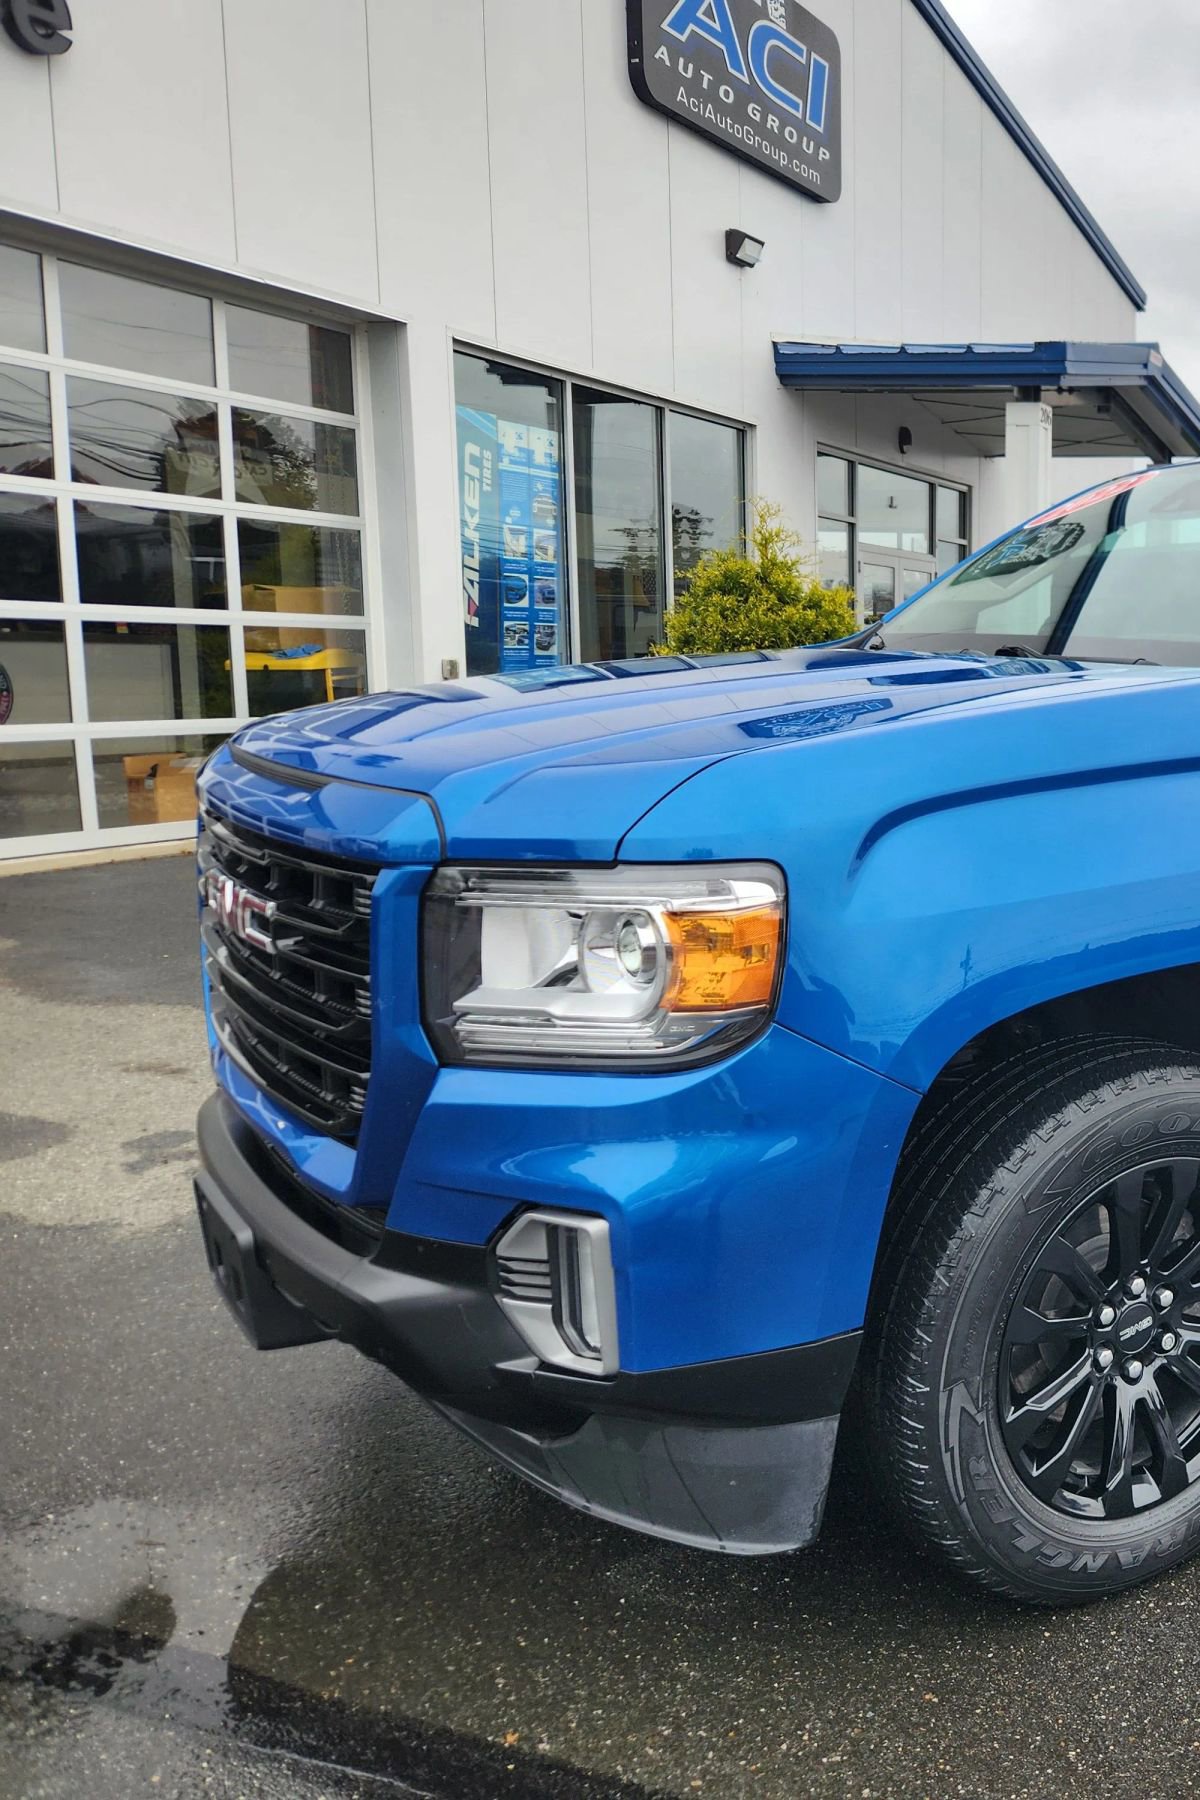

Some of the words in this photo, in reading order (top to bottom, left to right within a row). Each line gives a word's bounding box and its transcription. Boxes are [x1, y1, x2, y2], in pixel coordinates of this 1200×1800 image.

[654, 45, 735, 104] AUTO
[747, 102, 831, 162] GROUP
[660, 0, 829, 134] ACI
[676, 86, 821, 185] AciAutoGroup.com
[482, 449, 493, 492] TIRES
[463, 441, 480, 628] FALKEN
[206, 870, 277, 954] GMC
[1119, 1316, 1153, 1341] GMC
